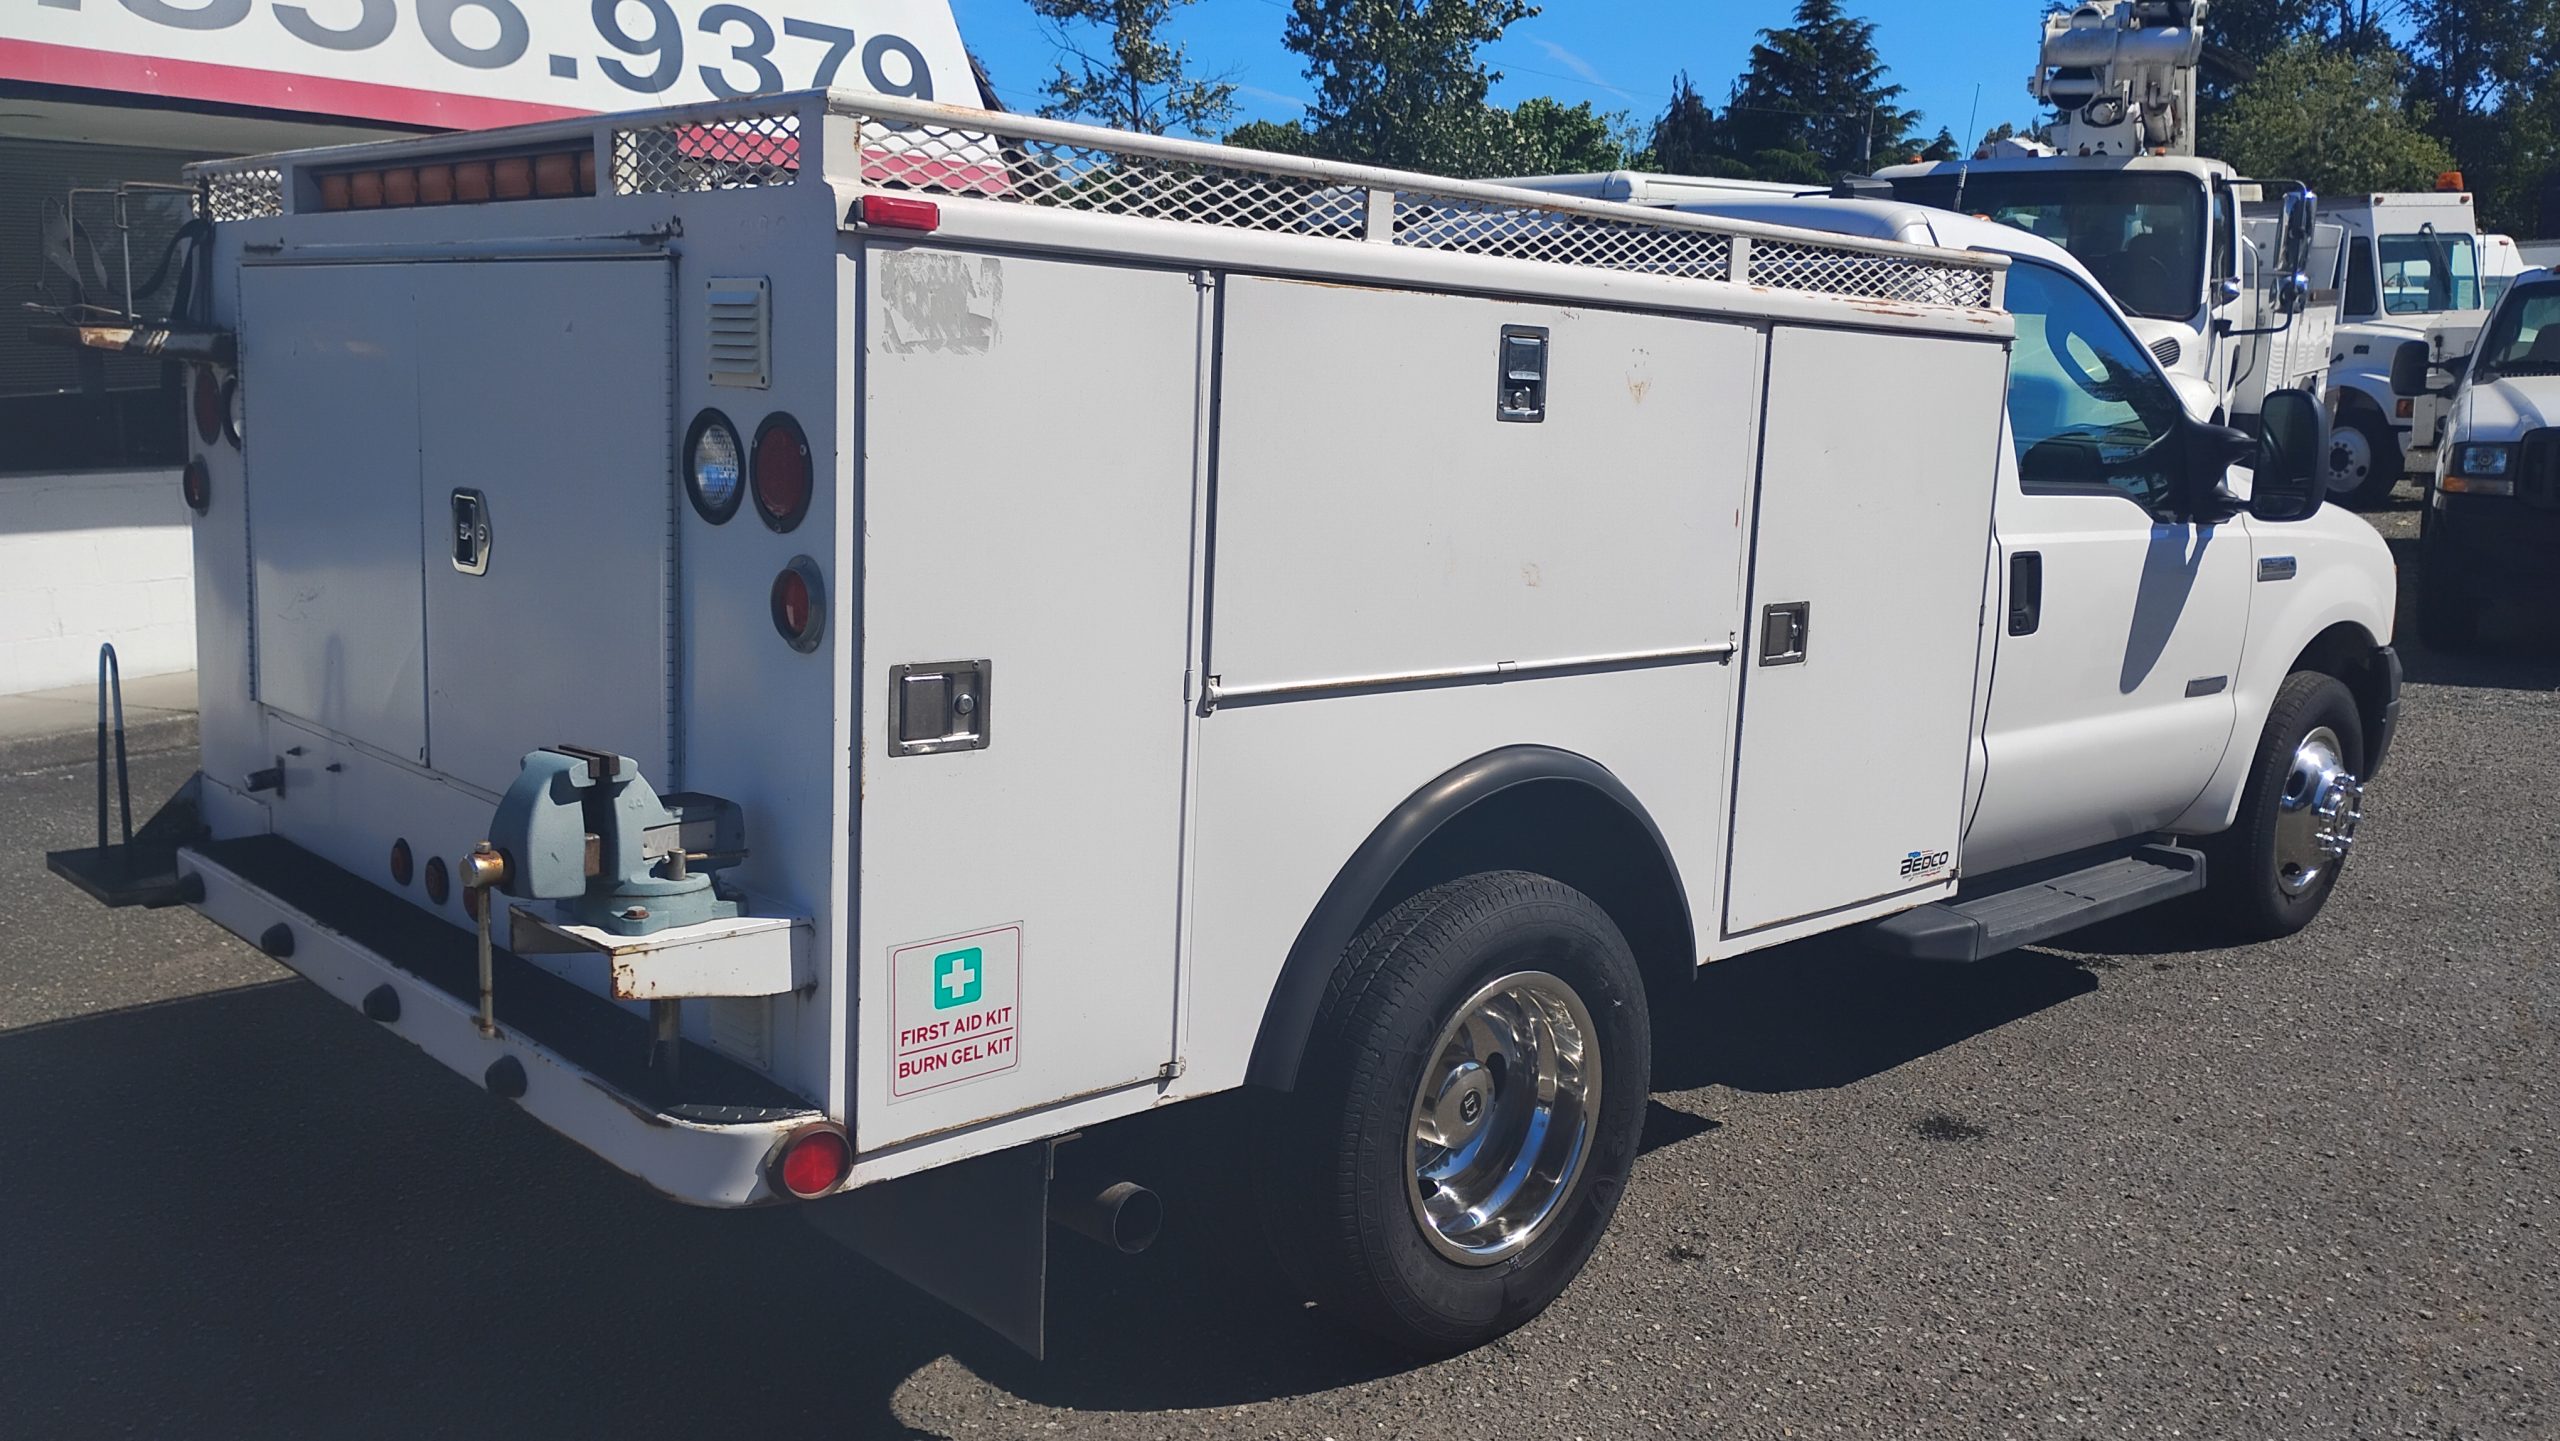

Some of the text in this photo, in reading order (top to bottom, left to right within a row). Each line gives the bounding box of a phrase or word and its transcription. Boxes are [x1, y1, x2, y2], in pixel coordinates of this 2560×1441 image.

[901, 1006, 1012, 1047] FIRST AID KIT
[899, 1036, 1013, 1079] BURN GEL KIT
